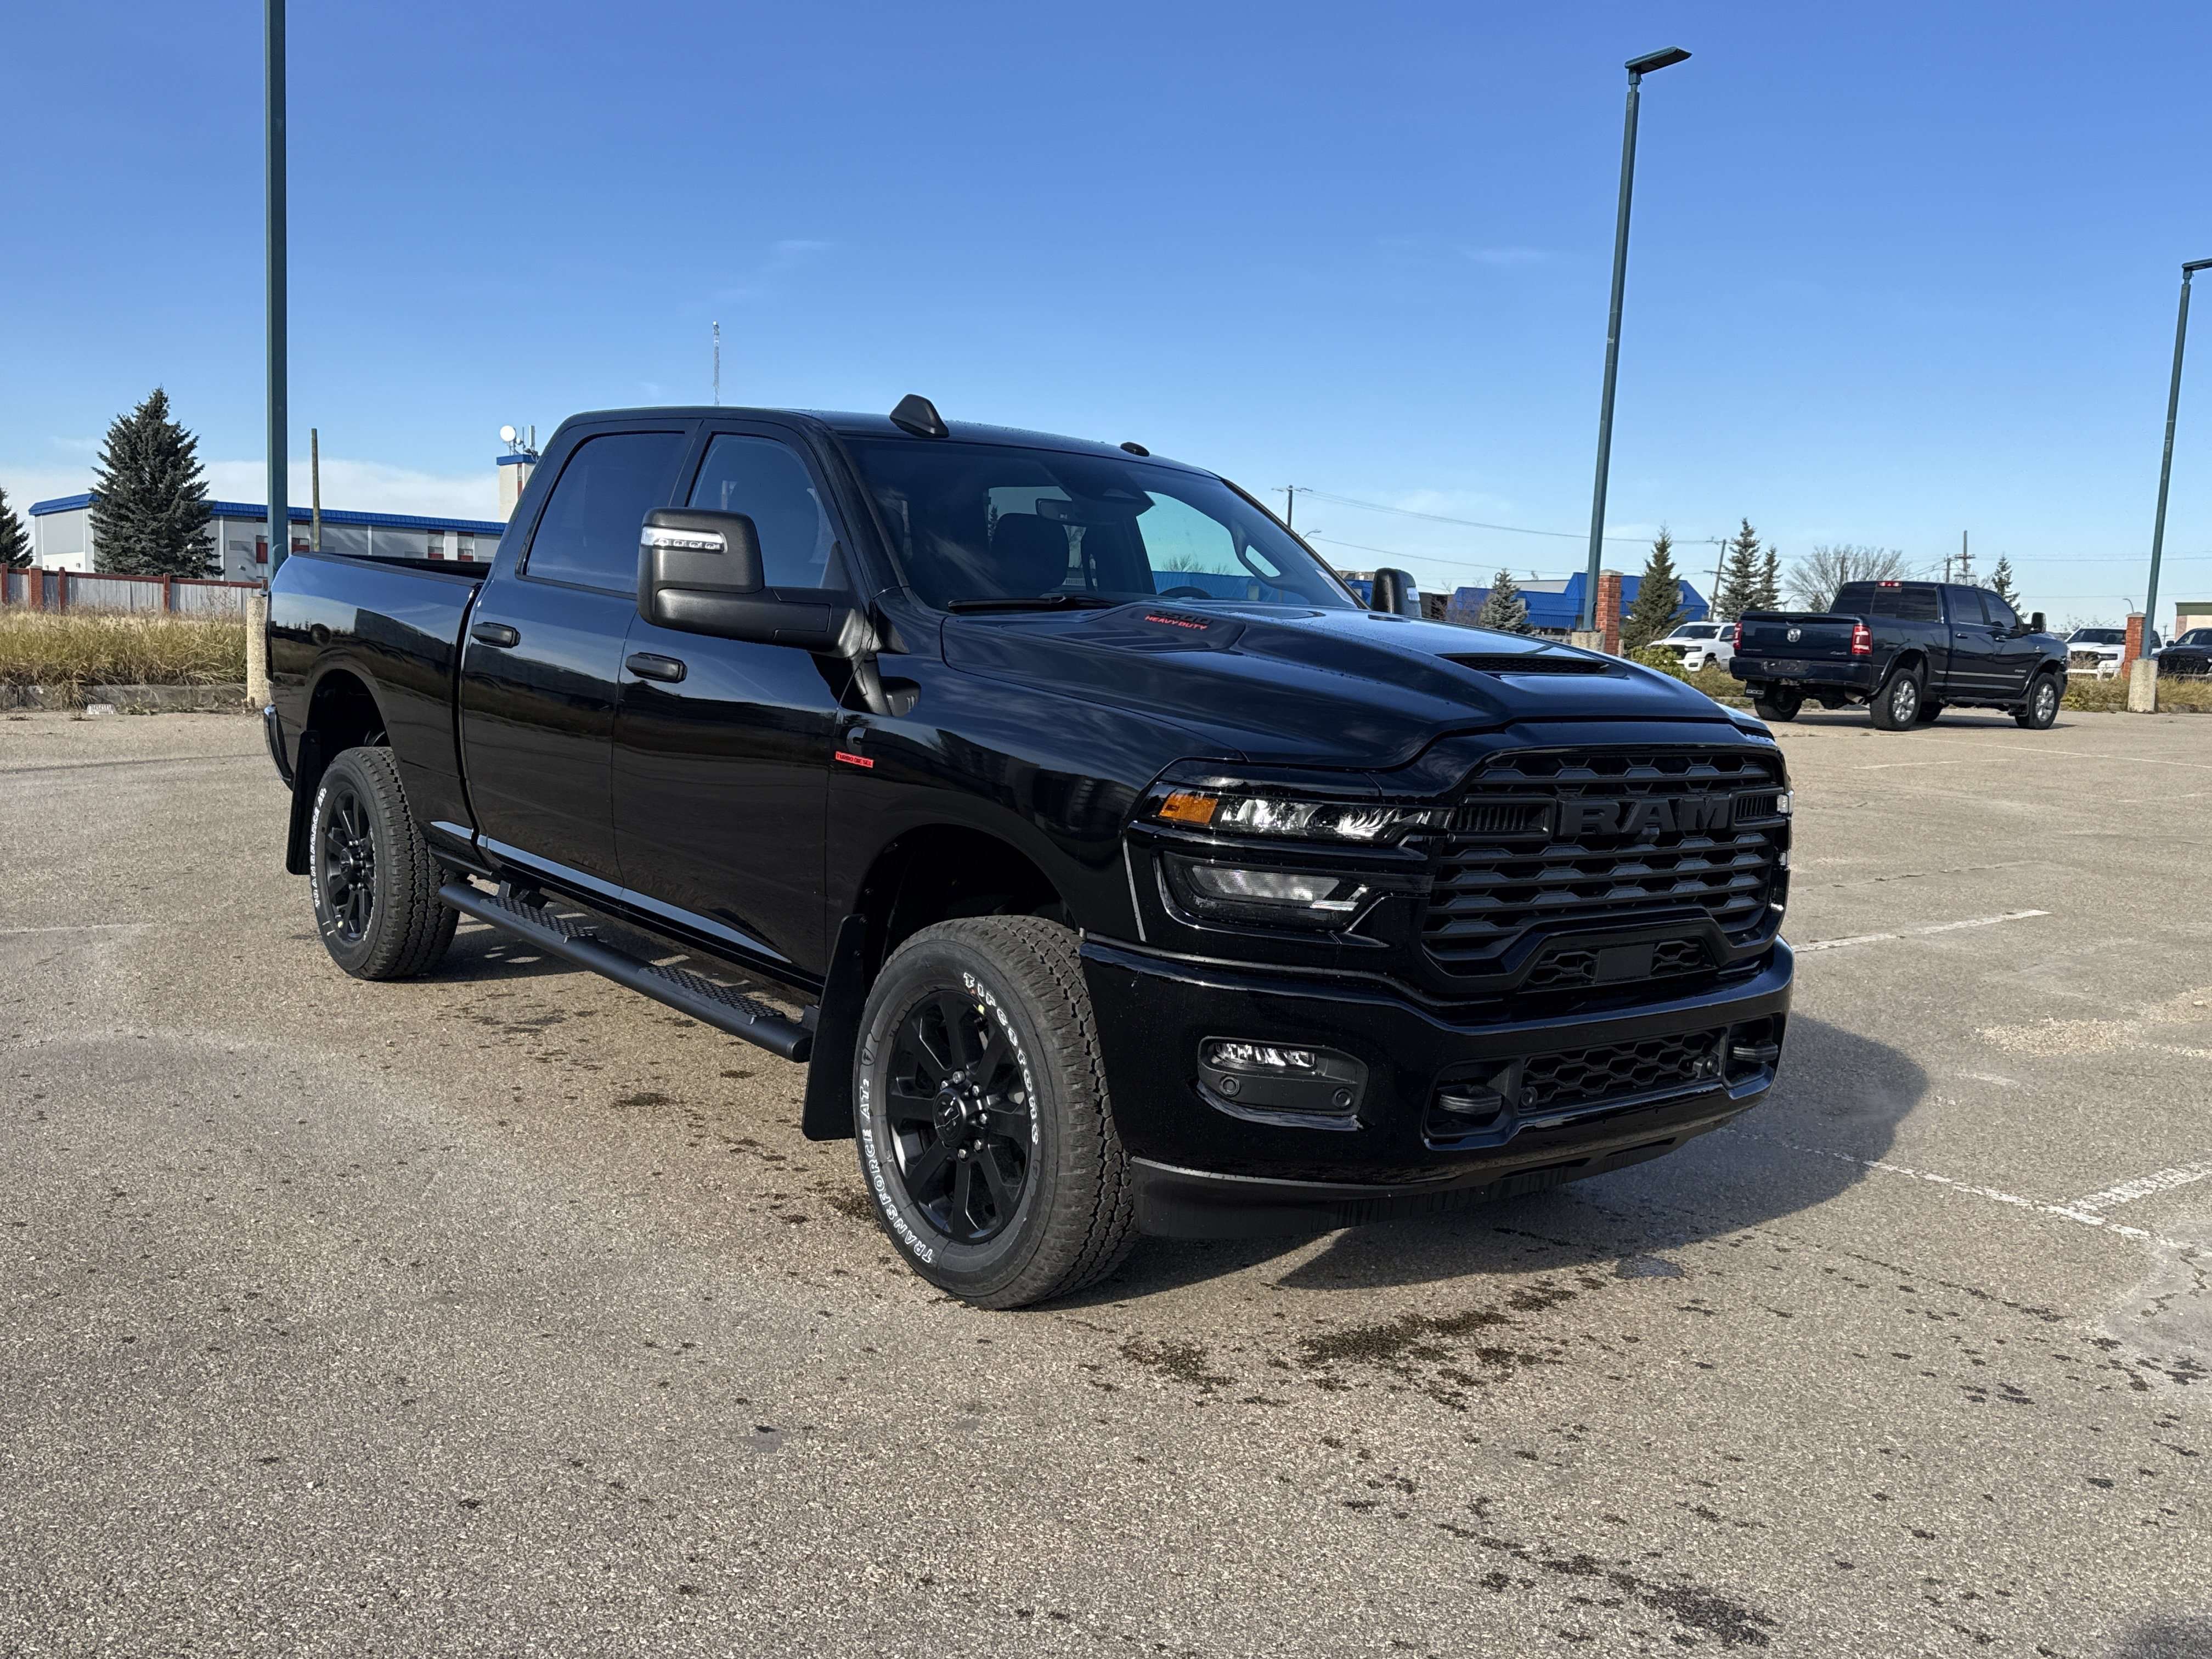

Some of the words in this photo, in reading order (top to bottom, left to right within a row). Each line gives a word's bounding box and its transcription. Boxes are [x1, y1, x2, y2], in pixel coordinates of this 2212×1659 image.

[1144, 614, 1178, 625] HEAVY
[1178, 621, 1207, 630] DUTY
[837, 753, 853, 761] TURBO
[854, 758, 871, 766] DIESEL
[1560, 797, 1729, 837] RAM
[862, 1128, 933, 1263] TRANSFORCE
